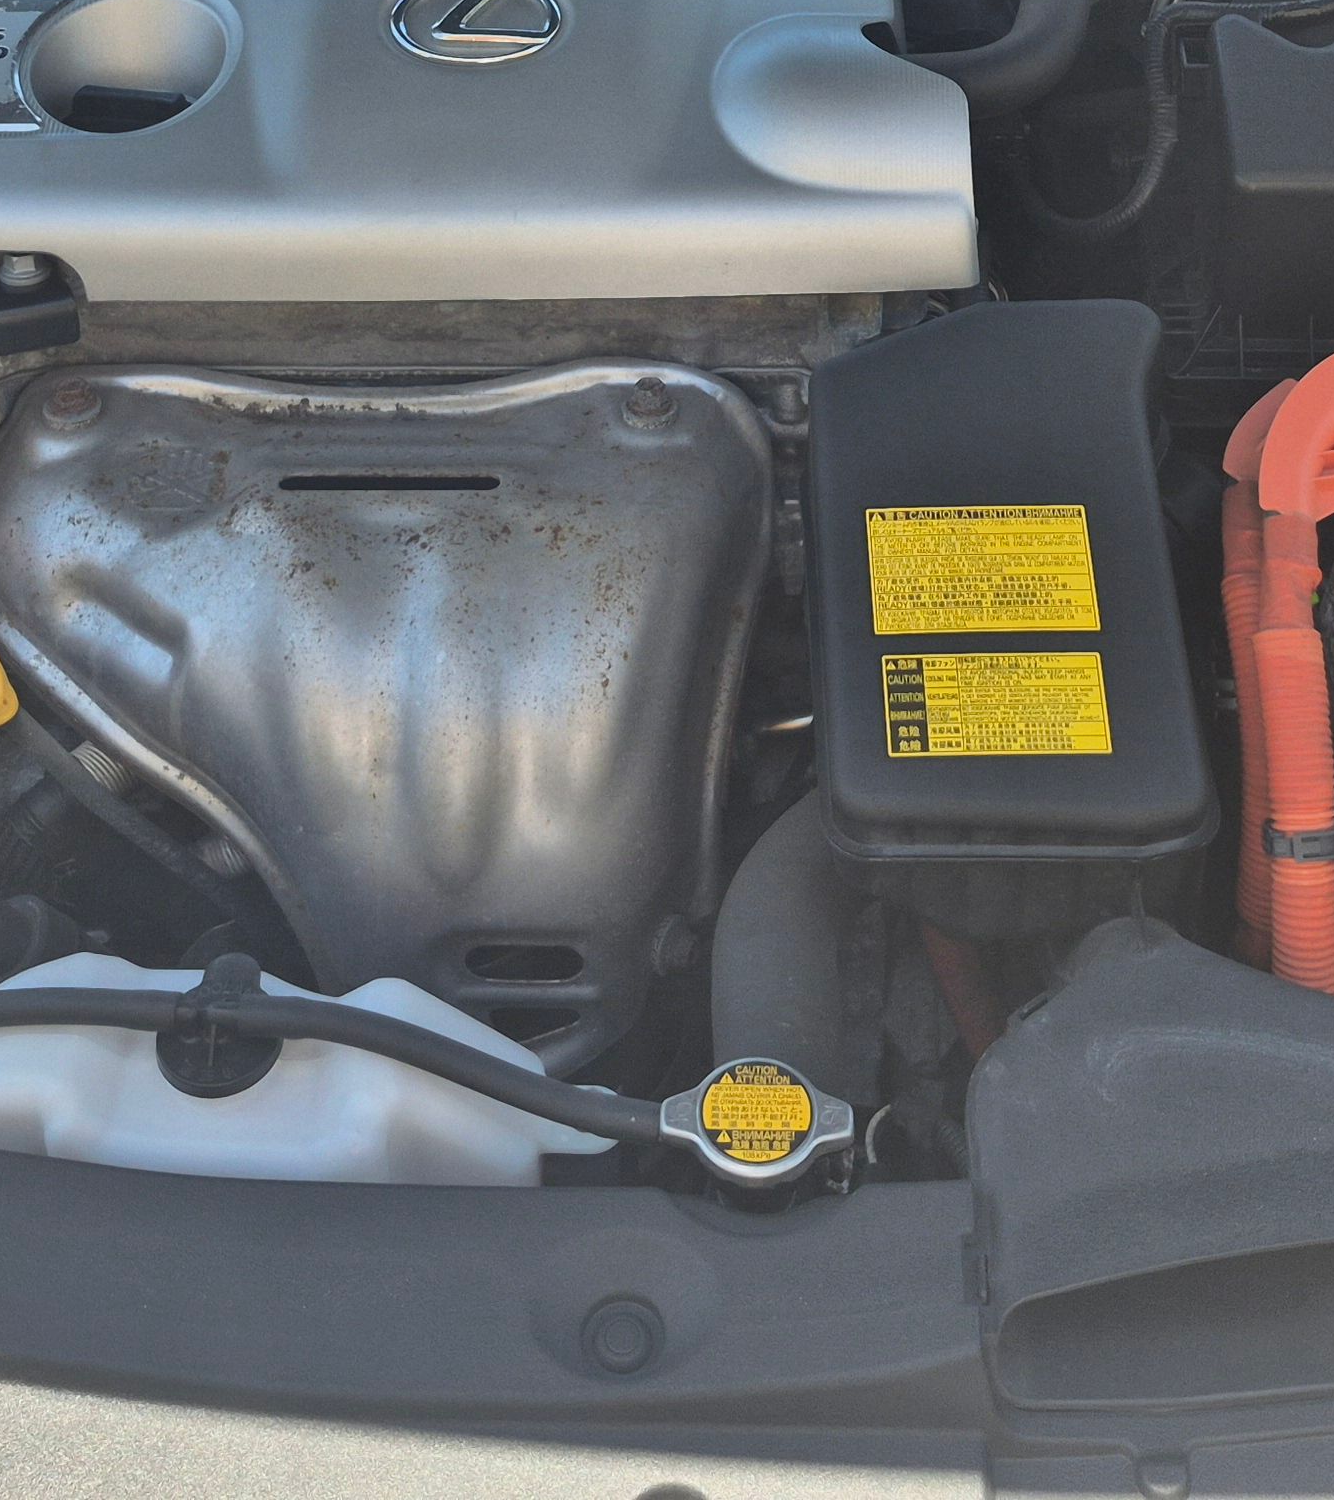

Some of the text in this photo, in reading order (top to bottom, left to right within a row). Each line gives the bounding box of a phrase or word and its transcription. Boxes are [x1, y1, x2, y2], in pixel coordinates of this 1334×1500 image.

[909, 510, 958, 520] CAUTION
[962, 509, 1023, 520] ATTENTION
[1026, 508, 1080, 518] ВНИМАНИЕ
[888, 674, 922, 685] CAUTION
[889, 692, 924, 703] ATTENTION
[735, 1065, 778, 1074] CAUTION
[735, 1075, 790, 1085] ATTENTION
[732, 1131, 795, 1140] ВНИМАНИЕ!
